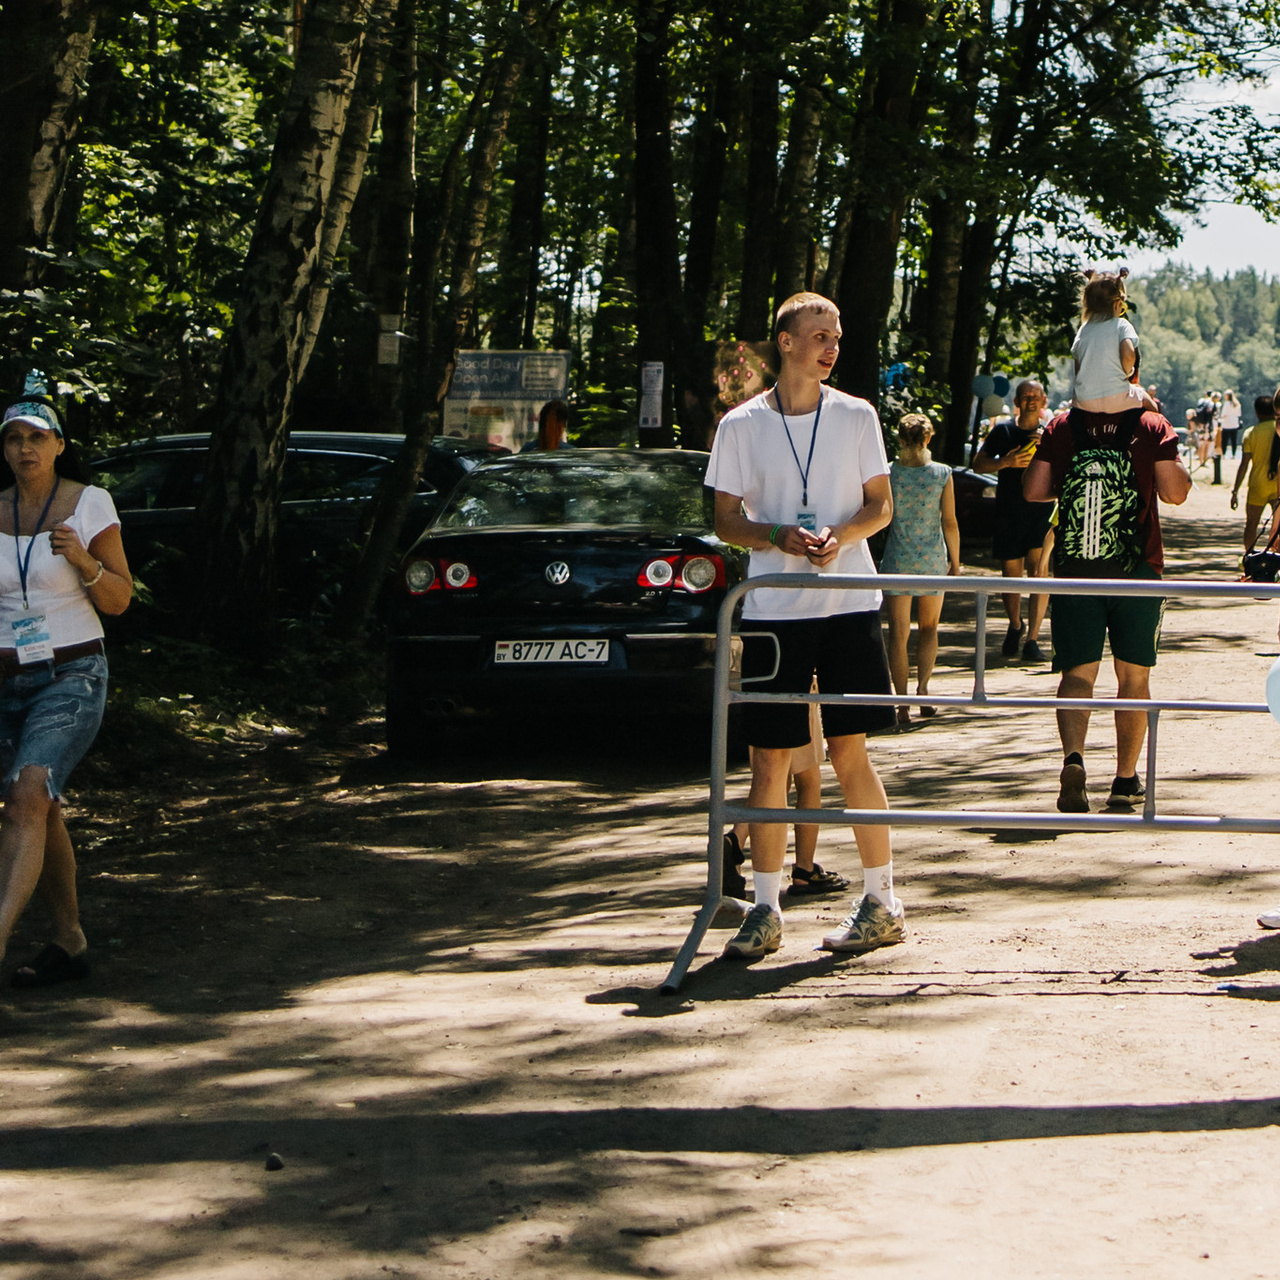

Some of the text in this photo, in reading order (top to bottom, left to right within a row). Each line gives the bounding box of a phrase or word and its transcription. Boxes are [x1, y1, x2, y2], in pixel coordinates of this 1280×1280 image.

[493, 357, 520, 372] Day
[453, 372, 488, 384] Open
[496, 641, 607, 661] BY 8777 AC-7
